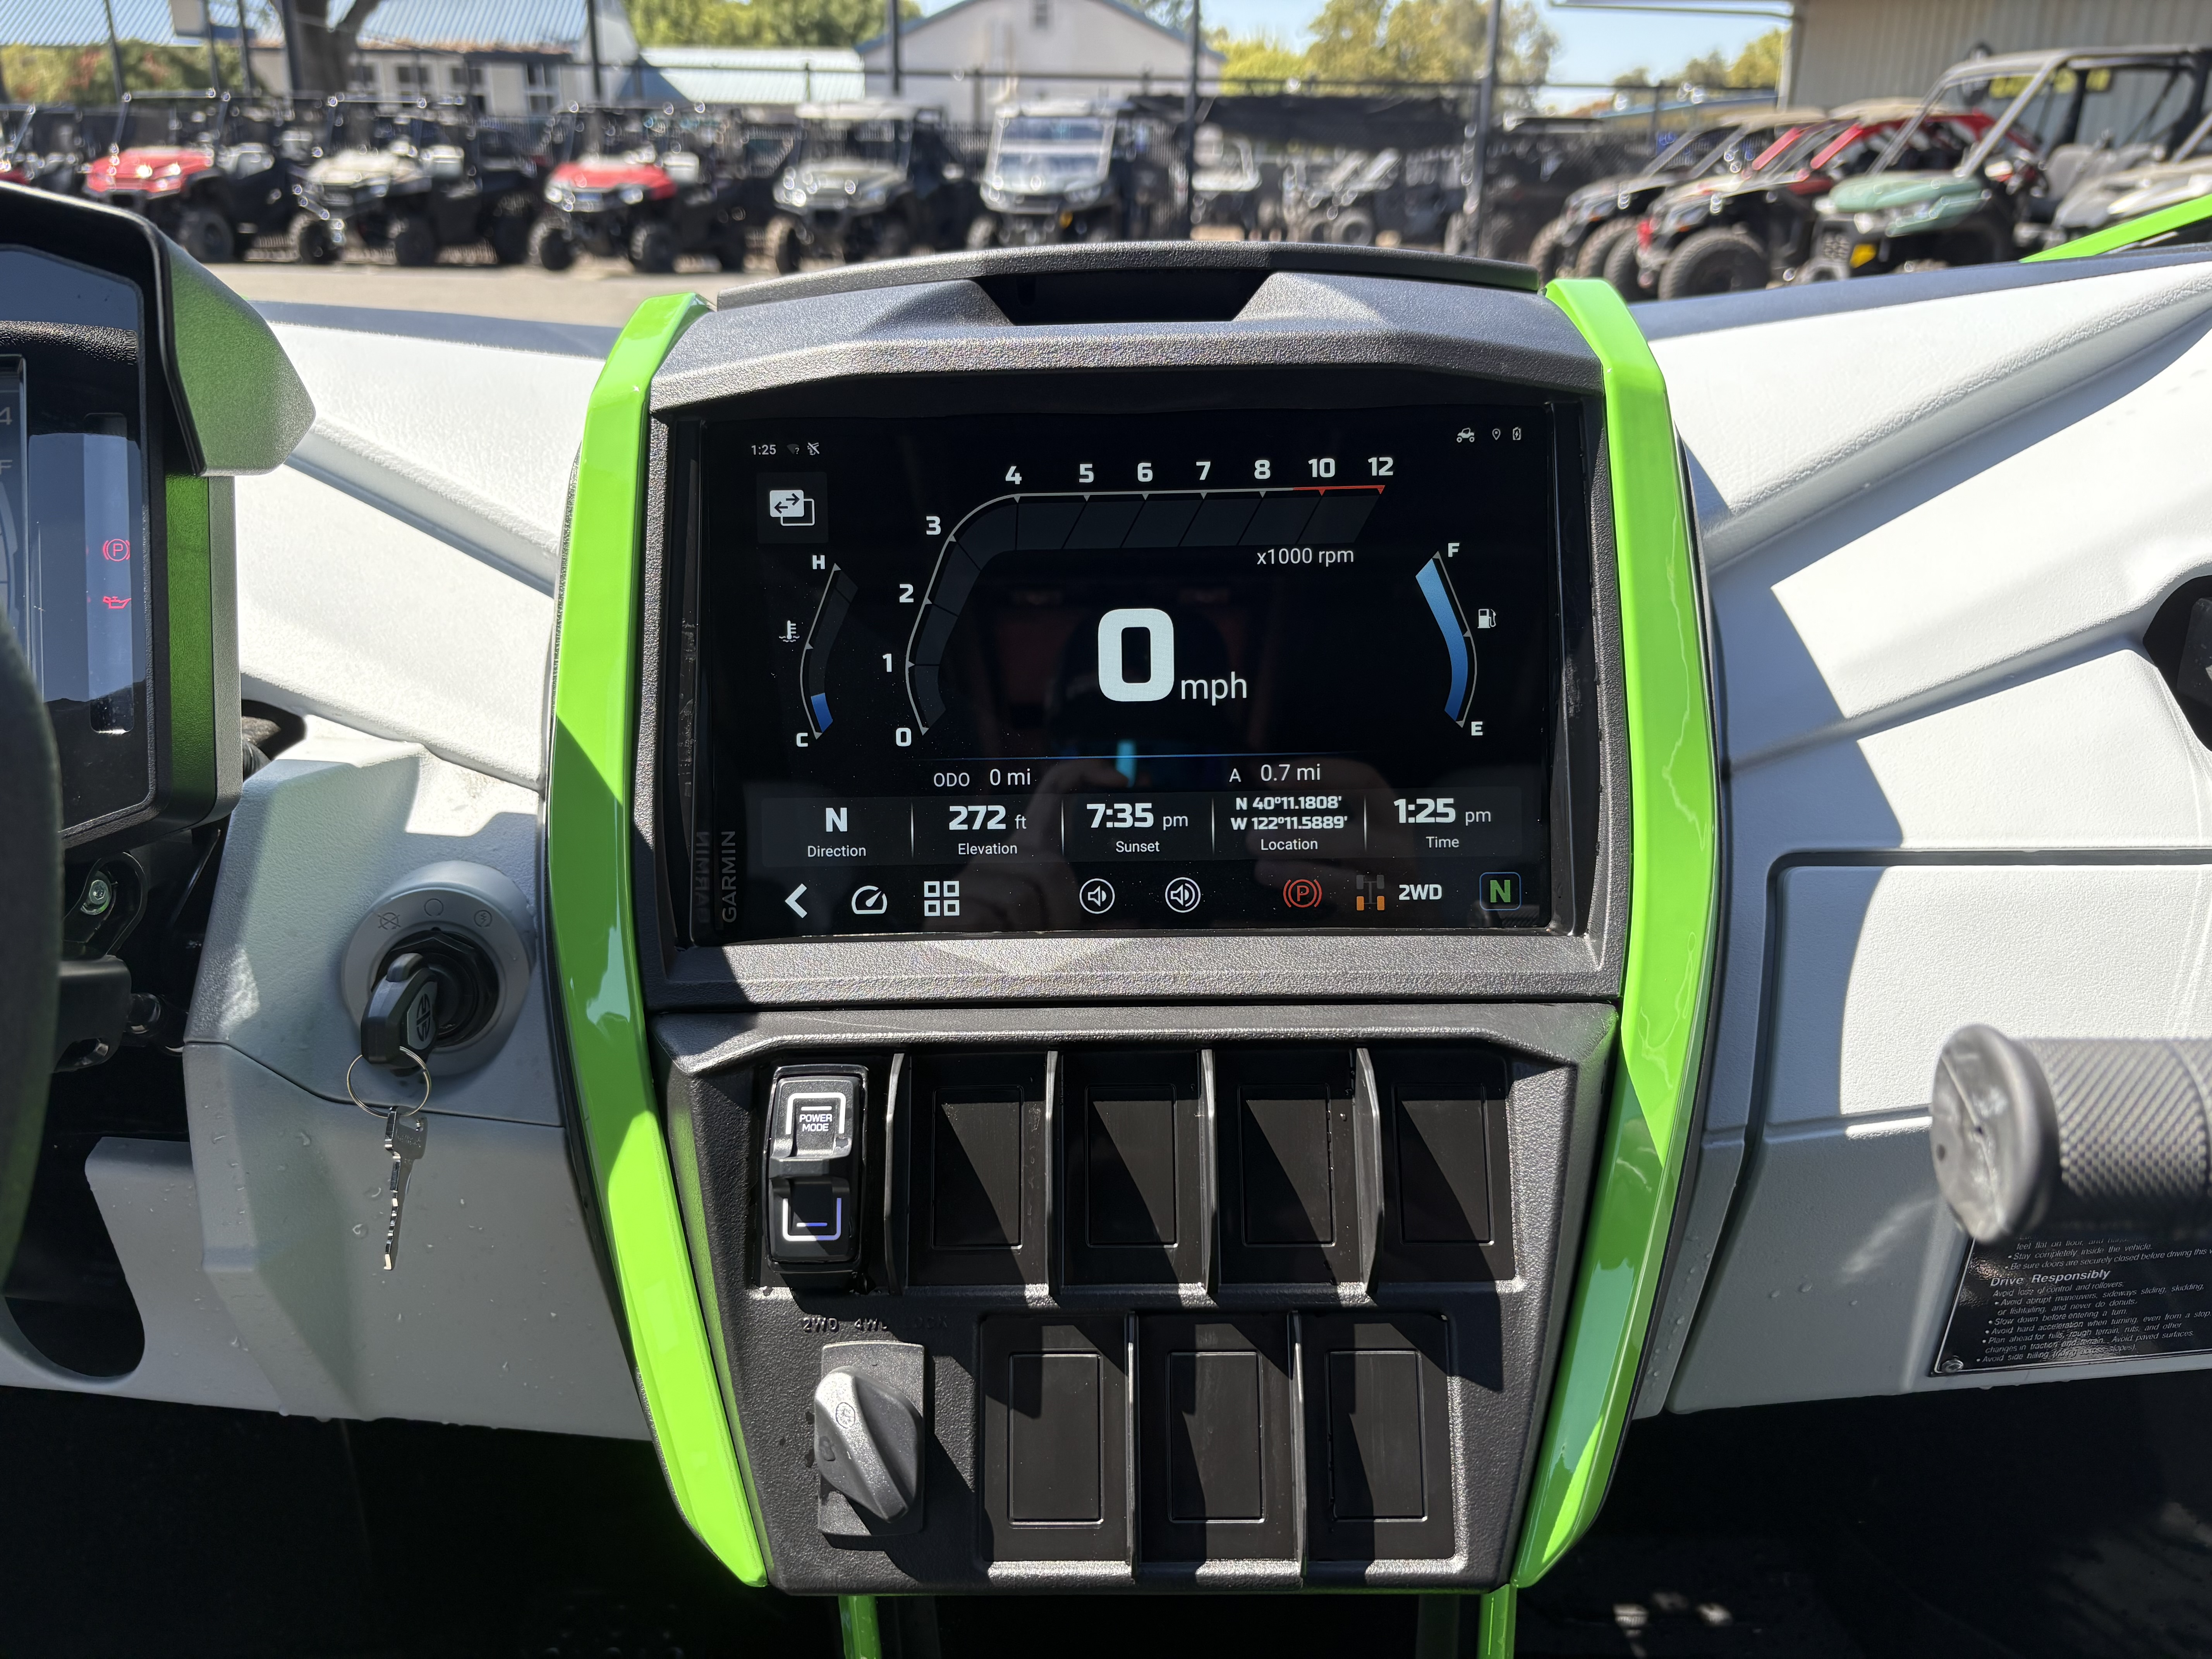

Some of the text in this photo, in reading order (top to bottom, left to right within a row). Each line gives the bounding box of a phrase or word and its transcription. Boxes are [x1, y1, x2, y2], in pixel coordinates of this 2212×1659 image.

[751, 444, 776, 455] 1:25
[1005, 465, 1022, 484] 4
[1079, 464, 1094, 483] 5
[1137, 462, 1153, 482] 6
[1196, 461, 1211, 480] 7
[1254, 459, 1271, 479] 8
[1308, 458, 1335, 478] 10
[1368, 457, 1393, 476] 12
[926, 516, 941, 535] 3
[1257, 548, 1354, 567] x1000 rpm
[1448, 543, 1460, 557] F
[812, 555, 825, 570] H
[899, 584, 914, 603] 2
[882, 653, 892, 672] 1
[1097, 608, 1247, 706] 0 mph
[895, 727, 912, 747] 0
[1471, 721, 1483, 736] E
[796, 732, 808, 747] C
[934, 768, 1030, 787] ODO 0 mi
[1229, 763, 1320, 782] A 0.7 mi
[1236, 797, 1247, 810] N
[1393, 798, 1491, 826] 1:25 pm
[826, 807, 848, 832] N
[949, 805, 1027, 830] 272 ft
[1086, 803, 1188, 831] 7:35 pm
[1230, 817, 1248, 830] W
[807, 845, 866, 857] Direction
[958, 843, 1017, 855] Elevation
[1116, 841, 1160, 852] Sunset
[1261, 839, 1318, 850] Location
[1425, 836, 1459, 848] Time
[721, 831, 737, 922] GARMIN
[1399, 884, 1442, 900] 2WD
[1490, 879, 1511, 903] N
[799, 1113, 833, 1122] POWER
[802, 1123, 829, 1132] MODE
[2035, 1249, 2078, 1259] completely
[2080, 1257, 2112, 1265] securely
[2114, 1254, 2140, 1262] closed
[2141, 1251, 2165, 1259] before
[2167, 1250, 2192, 1258] driving
[1990, 1269, 2111, 1286] Drive Responsibly
[2047, 1284, 2072, 1292] control
[2076, 1282, 2090, 1291] and
[2026, 1297, 2051, 1305] abrupt
[2102, 1290, 2137, 1298] sideways
[2038, 1321, 2083, 1331] acceleration
[1985, 1345, 2017, 1353] changes
[2135, 1333, 2159, 1341] paved
